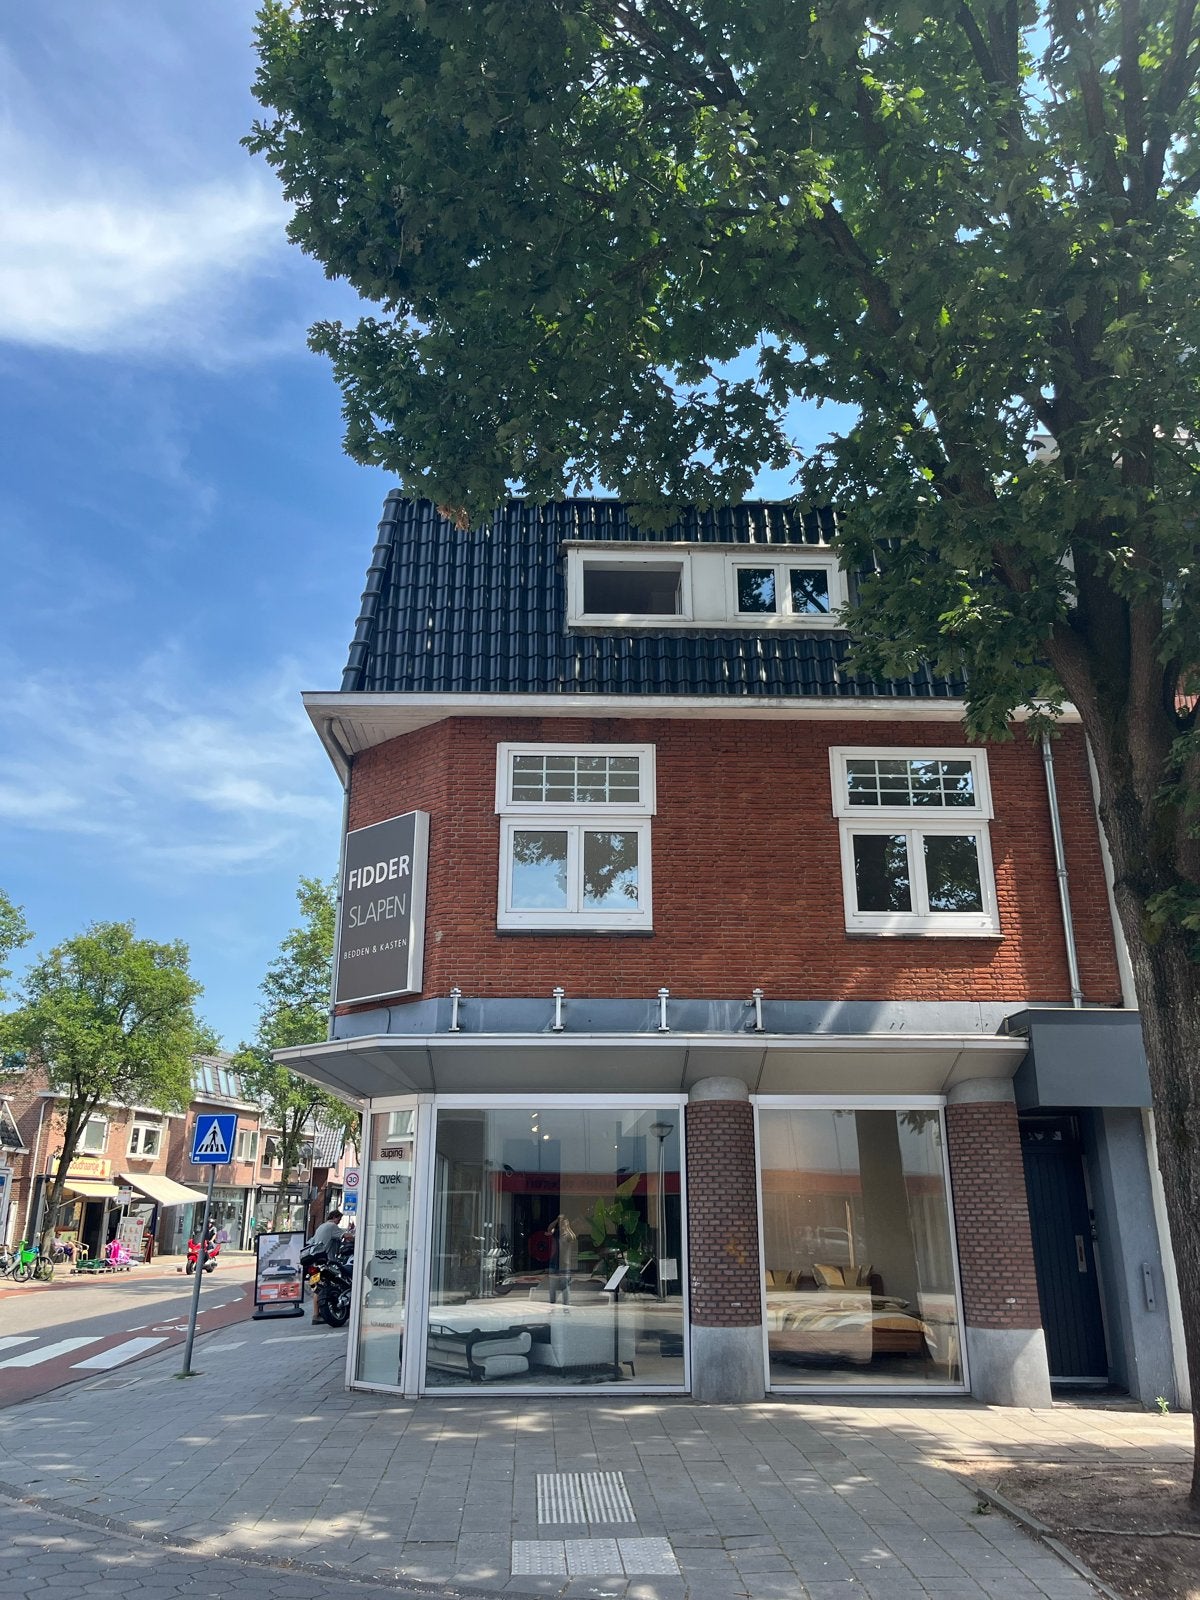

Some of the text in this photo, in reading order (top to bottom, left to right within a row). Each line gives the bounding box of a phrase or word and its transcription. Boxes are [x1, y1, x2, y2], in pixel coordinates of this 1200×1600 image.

[348, 855, 410, 891] FIDDER
[348, 893, 406, 928] SLAPEN
[343, 938, 407, 960] BEDDEN & KASTEN
[380, 1148, 403, 1159] auping
[379, 1171, 401, 1184] avek
